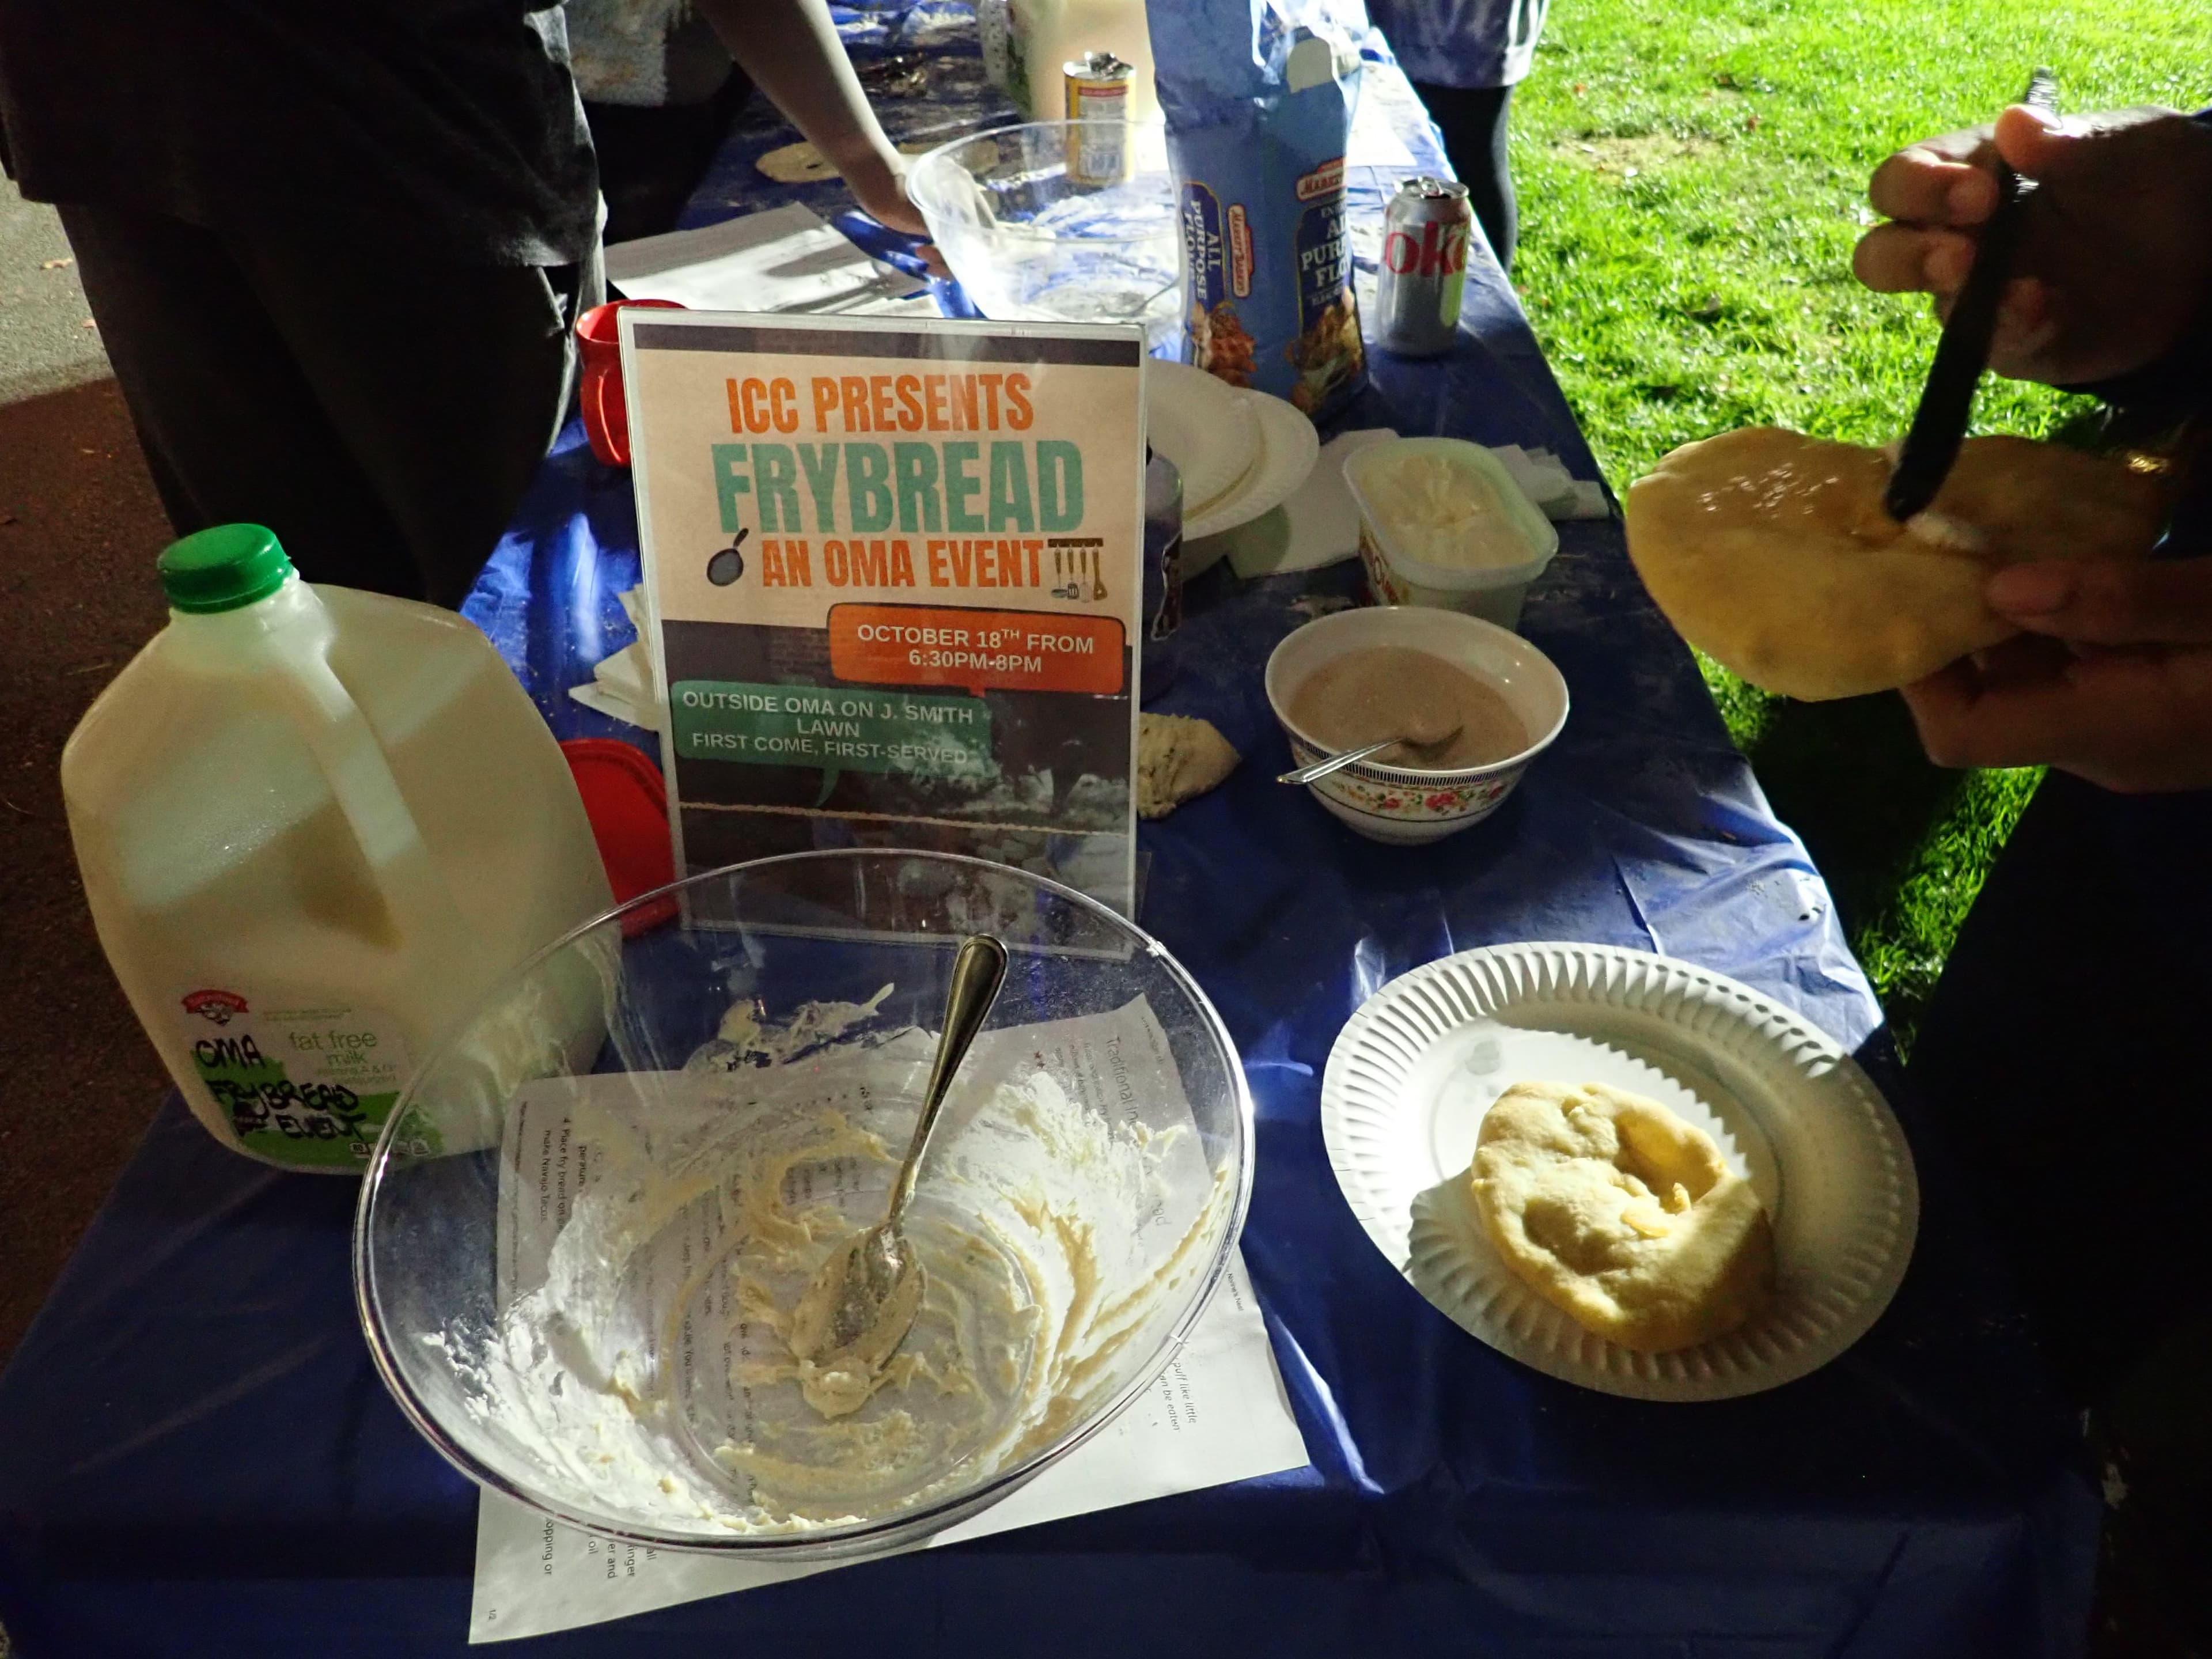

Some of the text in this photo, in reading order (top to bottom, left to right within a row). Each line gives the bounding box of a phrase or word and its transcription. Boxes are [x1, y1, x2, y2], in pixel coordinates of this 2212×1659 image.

[1190, 200, 1207, 300] PURPOSE
[1206, 232, 1222, 272] ALL
[726, 373, 1034, 434] ICC PRESENTS
[711, 440, 1085, 534] FRYBREAD
[762, 539, 1044, 588] AN OMA EVENT
[857, 624, 969, 647] OCTOBER
[1028, 634, 1093, 654] FROM
[908, 649, 1041, 673] 6:30PM-8PM
[683, 691, 974, 725] OUTSIDE OMA ON J. SMITH
[797, 717, 860, 738] LAWN
[692, 733, 967, 764] FIRST COME, FIRST-SERVED
[196, 1035, 266, 1069] OMA
[289, 1029, 378, 1051] fat free
[1107, 1036, 1134, 1104] Traditional
[1163, 1389, 1172, 1402] be
[1180, 1384, 1190, 1400] like
[1166, 1403, 1180, 1431] eaten
[1184, 1402, 1198, 1423] little
[588, 1540, 599, 1555] oil
[543, 1563, 553, 1576] or
[607, 1557, 618, 1580] and
